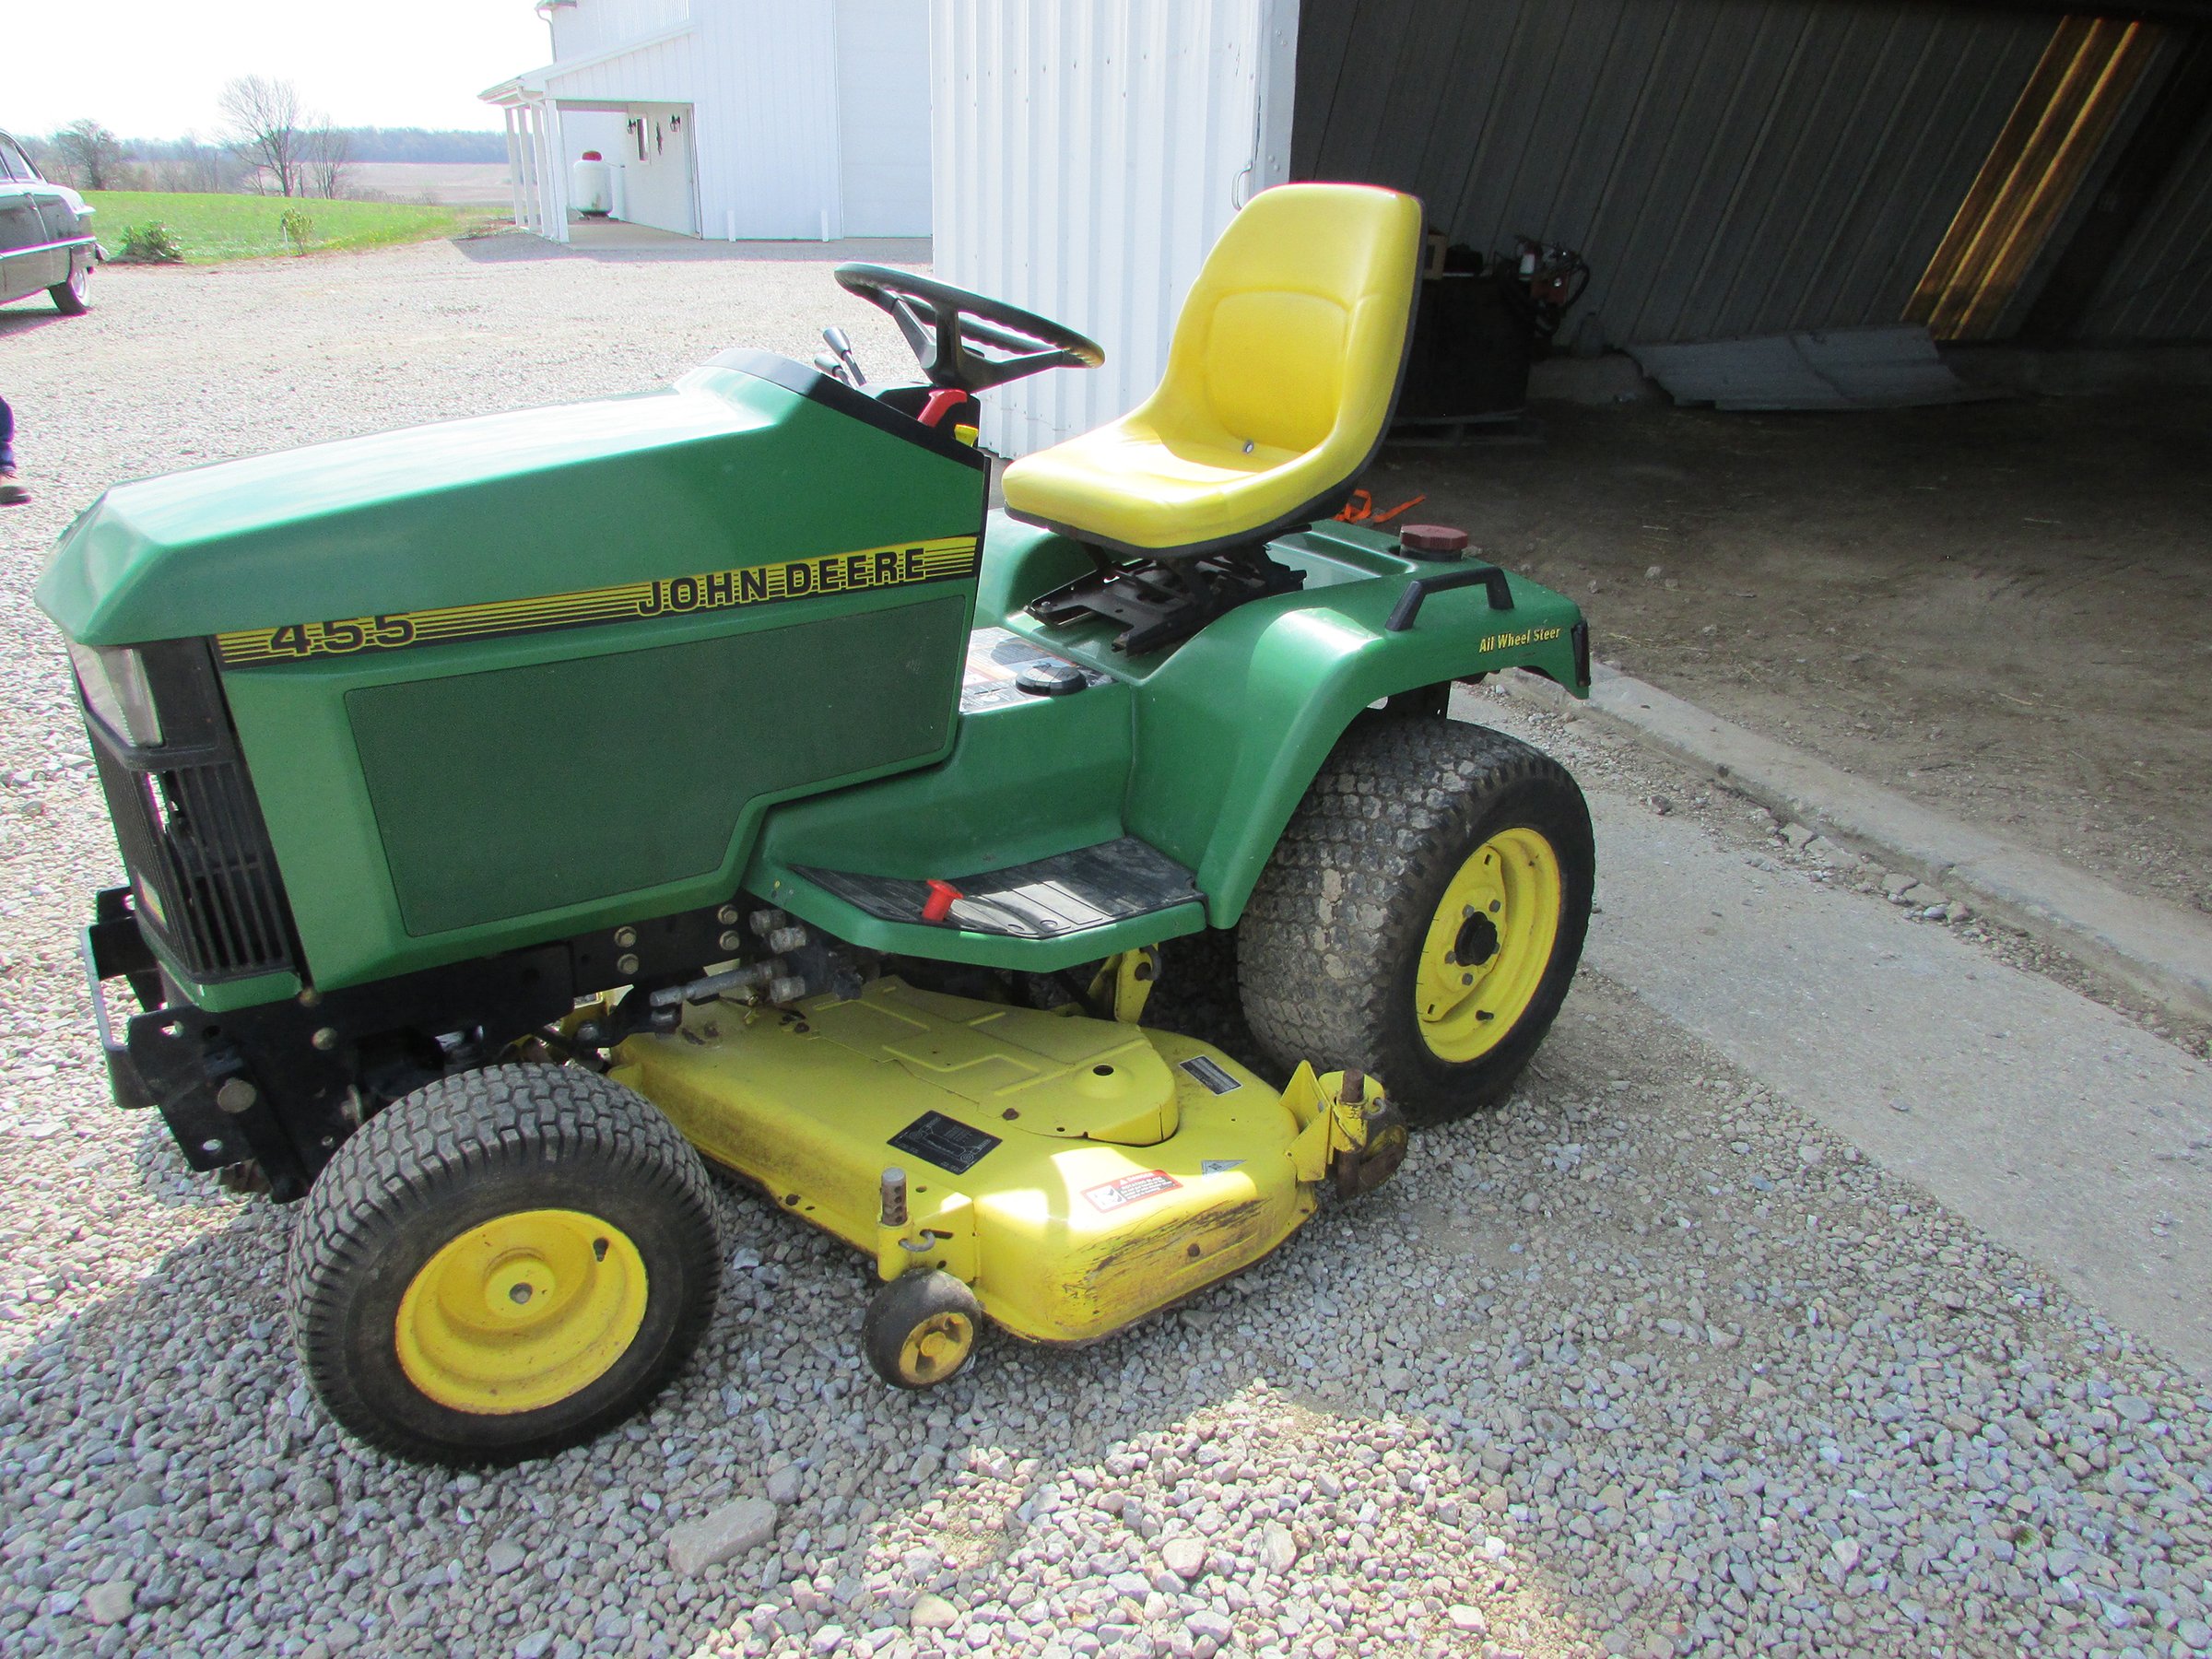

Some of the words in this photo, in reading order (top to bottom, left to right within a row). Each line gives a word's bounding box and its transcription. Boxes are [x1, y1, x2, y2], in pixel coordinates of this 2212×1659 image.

[637, 567, 770, 617] JOHN
[785, 547, 925, 596] DEERE
[268, 613, 417, 656] 455
[1478, 635, 1494, 653] All
[1498, 629, 1531, 649] Wheel
[1533, 627, 1561, 641] Steer
